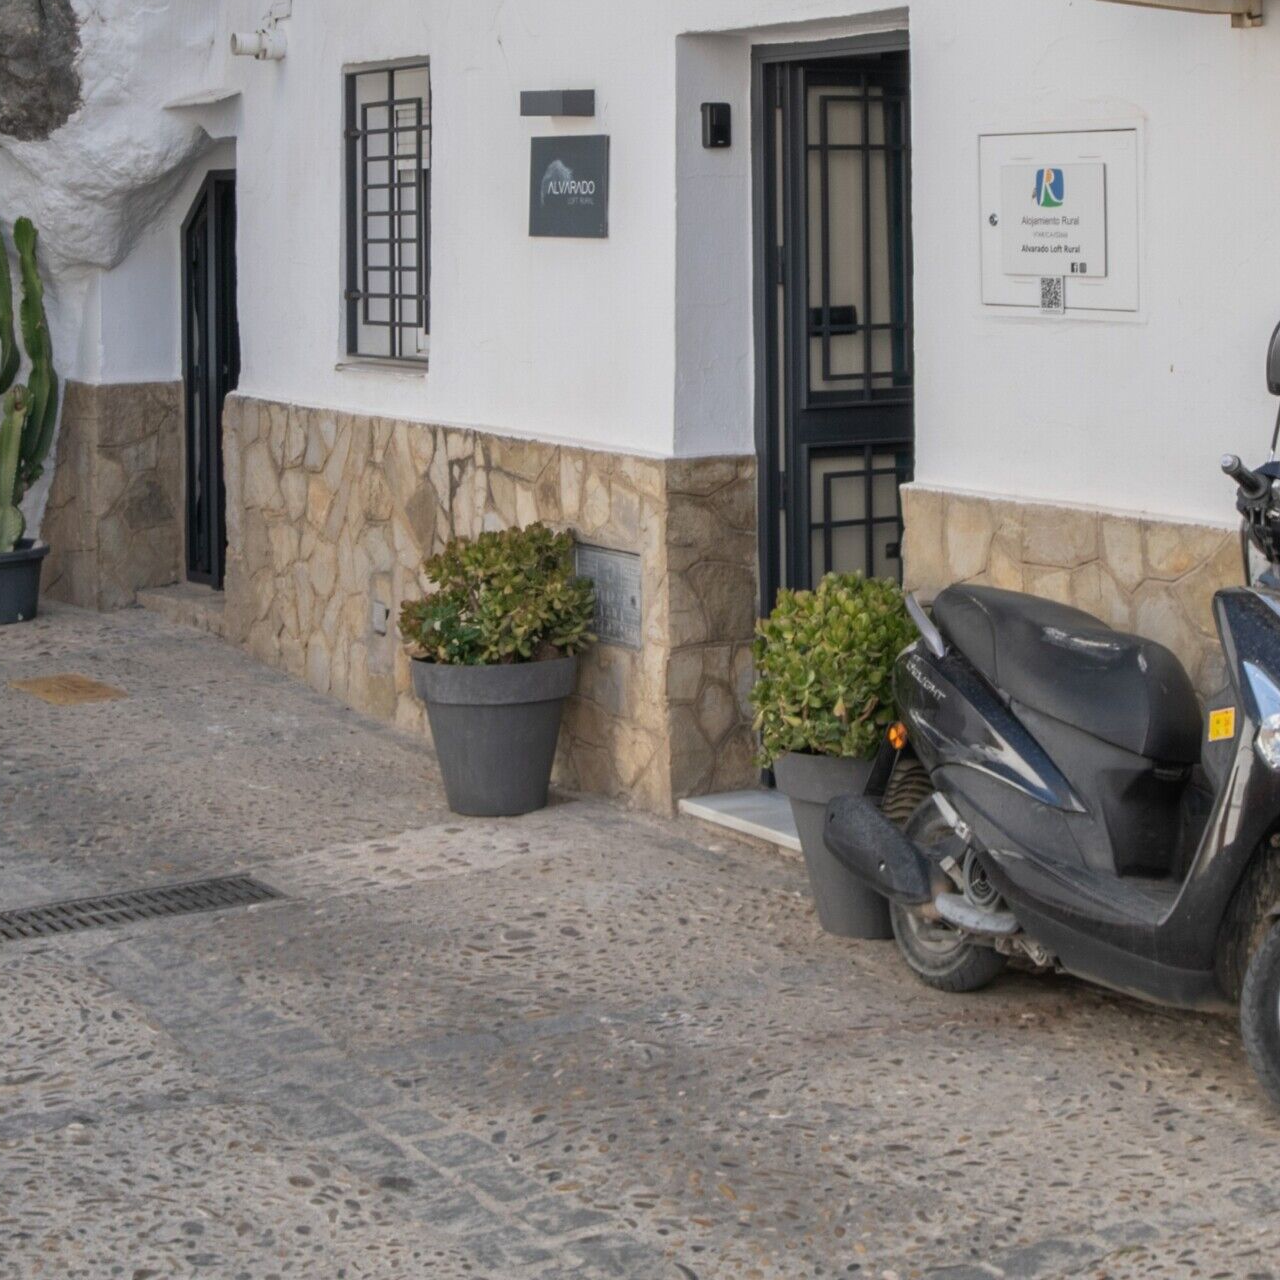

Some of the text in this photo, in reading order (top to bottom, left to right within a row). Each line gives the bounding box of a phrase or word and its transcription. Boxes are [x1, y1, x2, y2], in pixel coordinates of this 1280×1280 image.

[547, 180, 596, 195] ALVARADO
[1061, 215, 1079, 225] Rural
[1021, 244, 1081, 253] Alvarado Loft Rural
